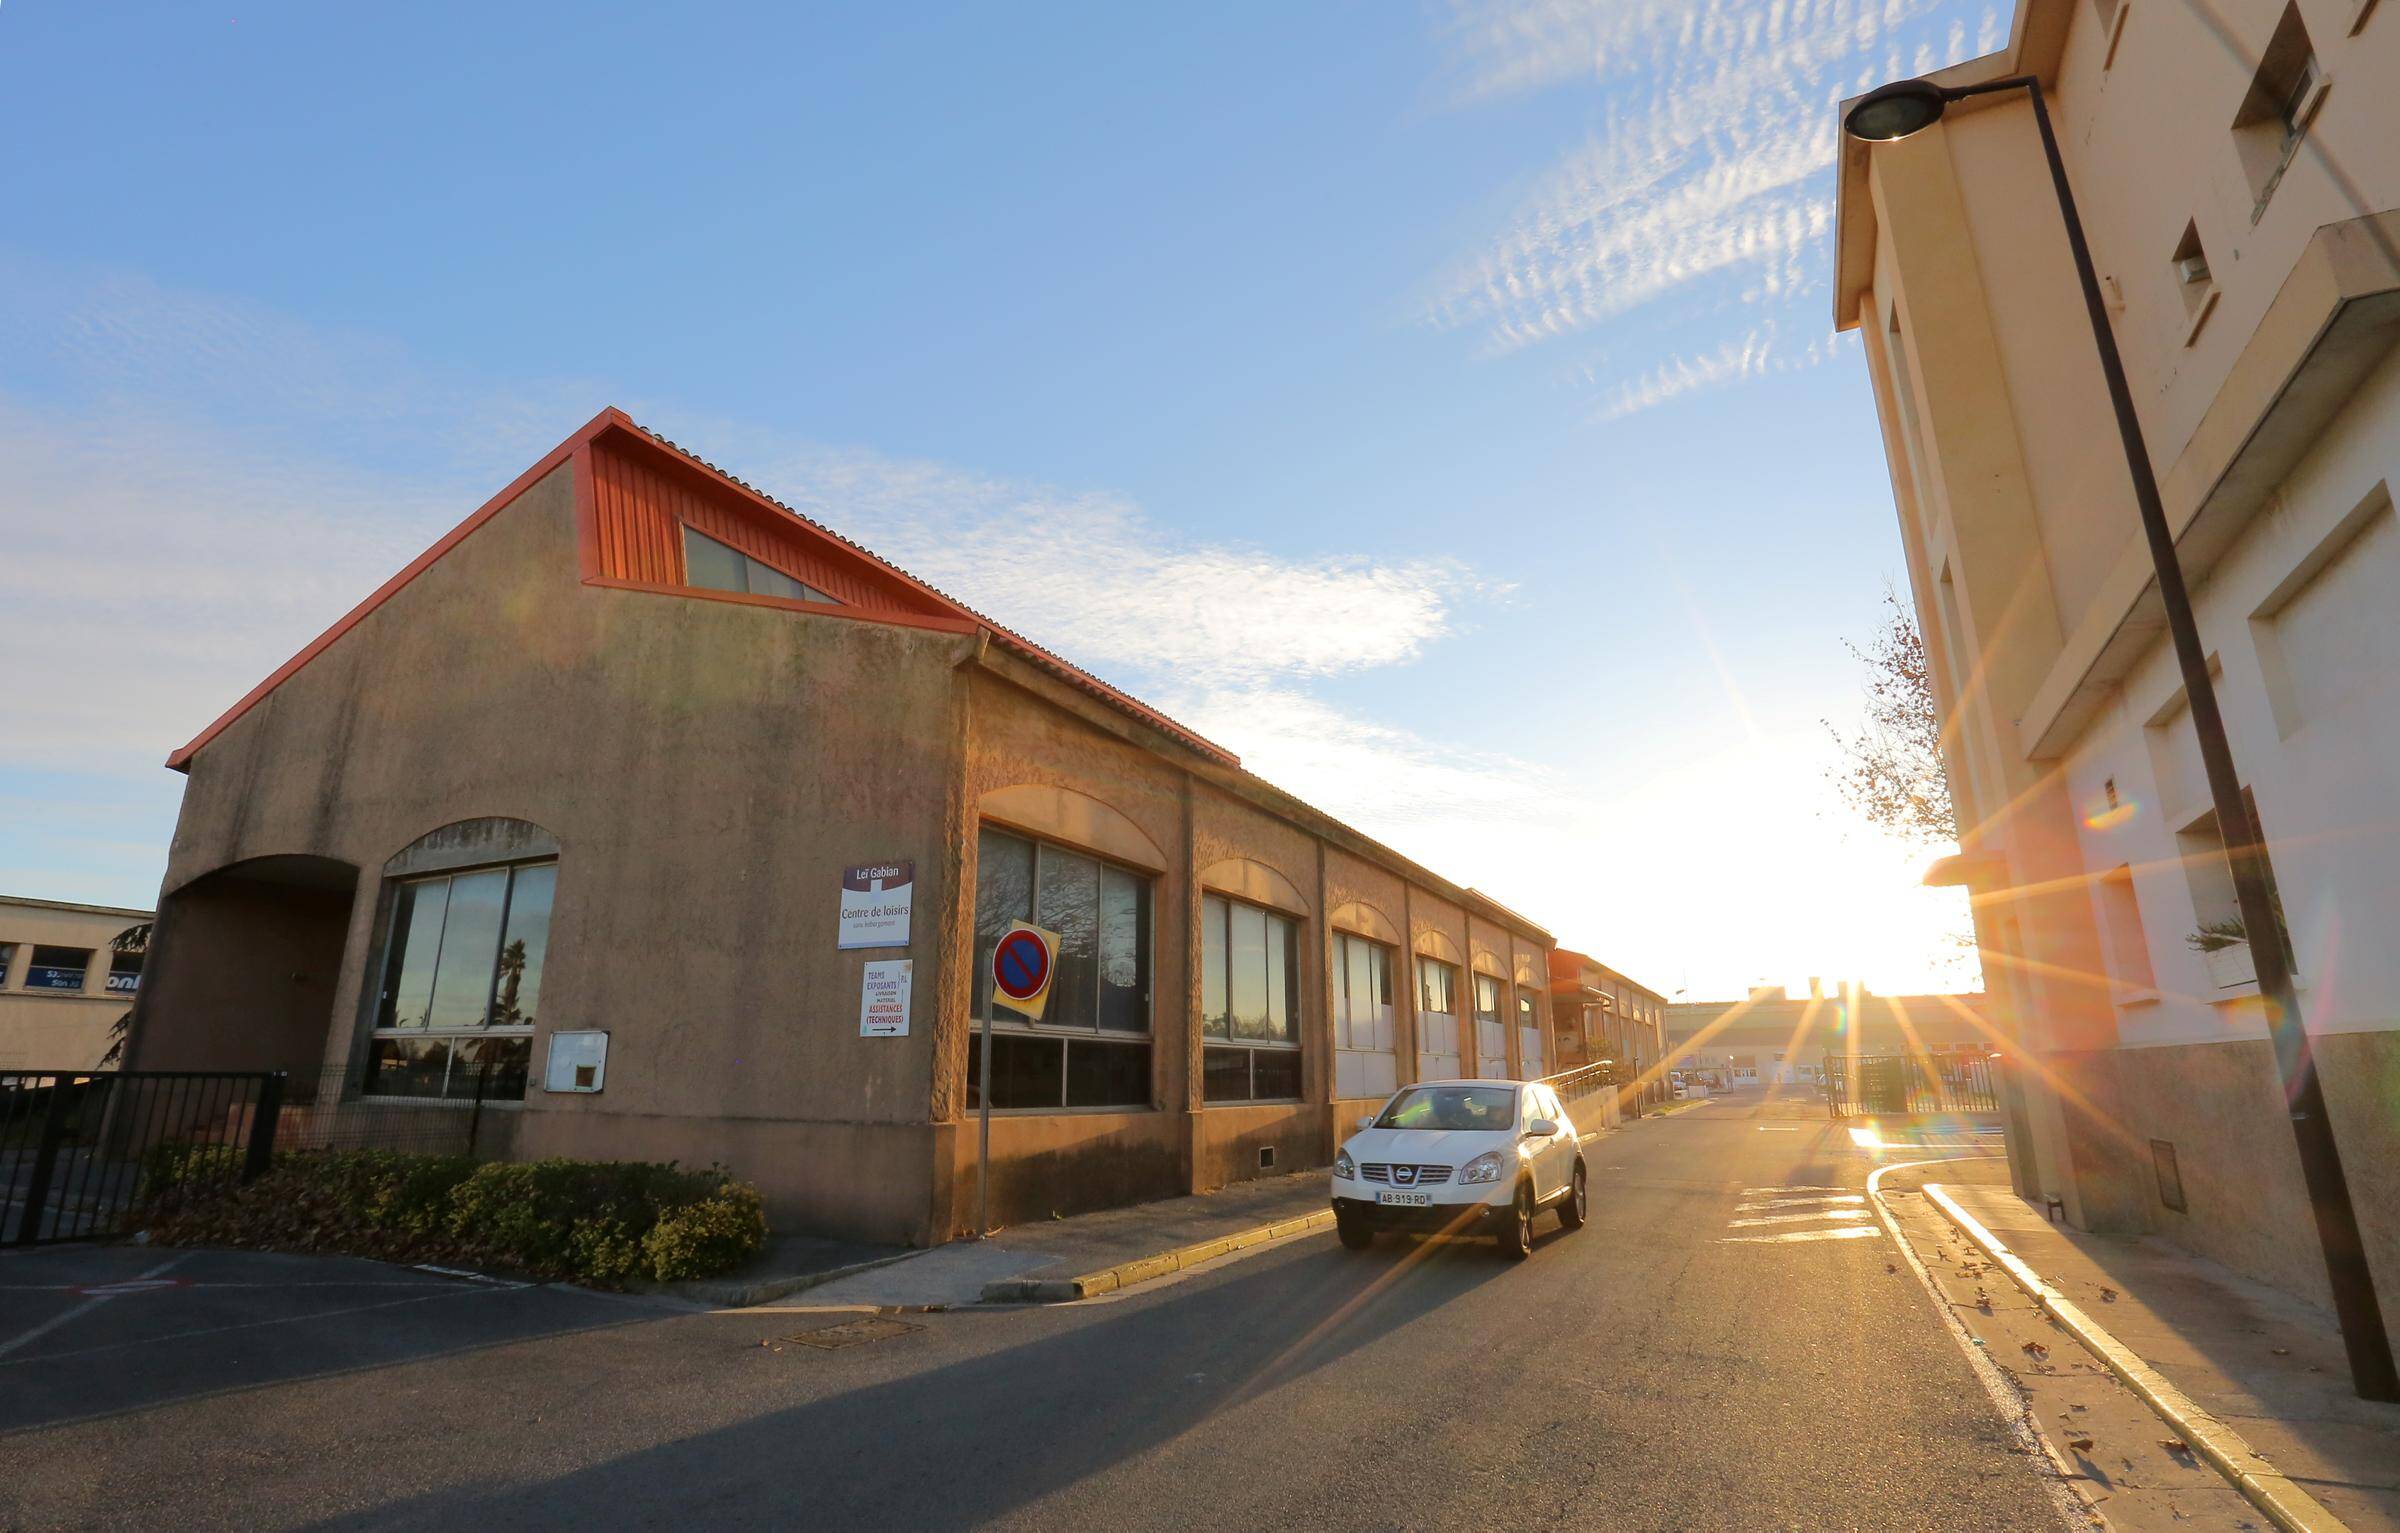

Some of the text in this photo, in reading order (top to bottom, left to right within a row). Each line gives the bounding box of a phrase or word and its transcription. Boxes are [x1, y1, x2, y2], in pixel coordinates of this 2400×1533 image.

[856, 866, 899, 880] Leï Gabian
[842, 905, 909, 919] Centre de loisirs
[868, 971, 885, 980] TEAMS
[867, 981, 897, 990] EXPOSANTS
[868, 1004, 903, 1013] ASSISTANCES
[866, 1015, 904, 1025] (TECHNIQUES)
